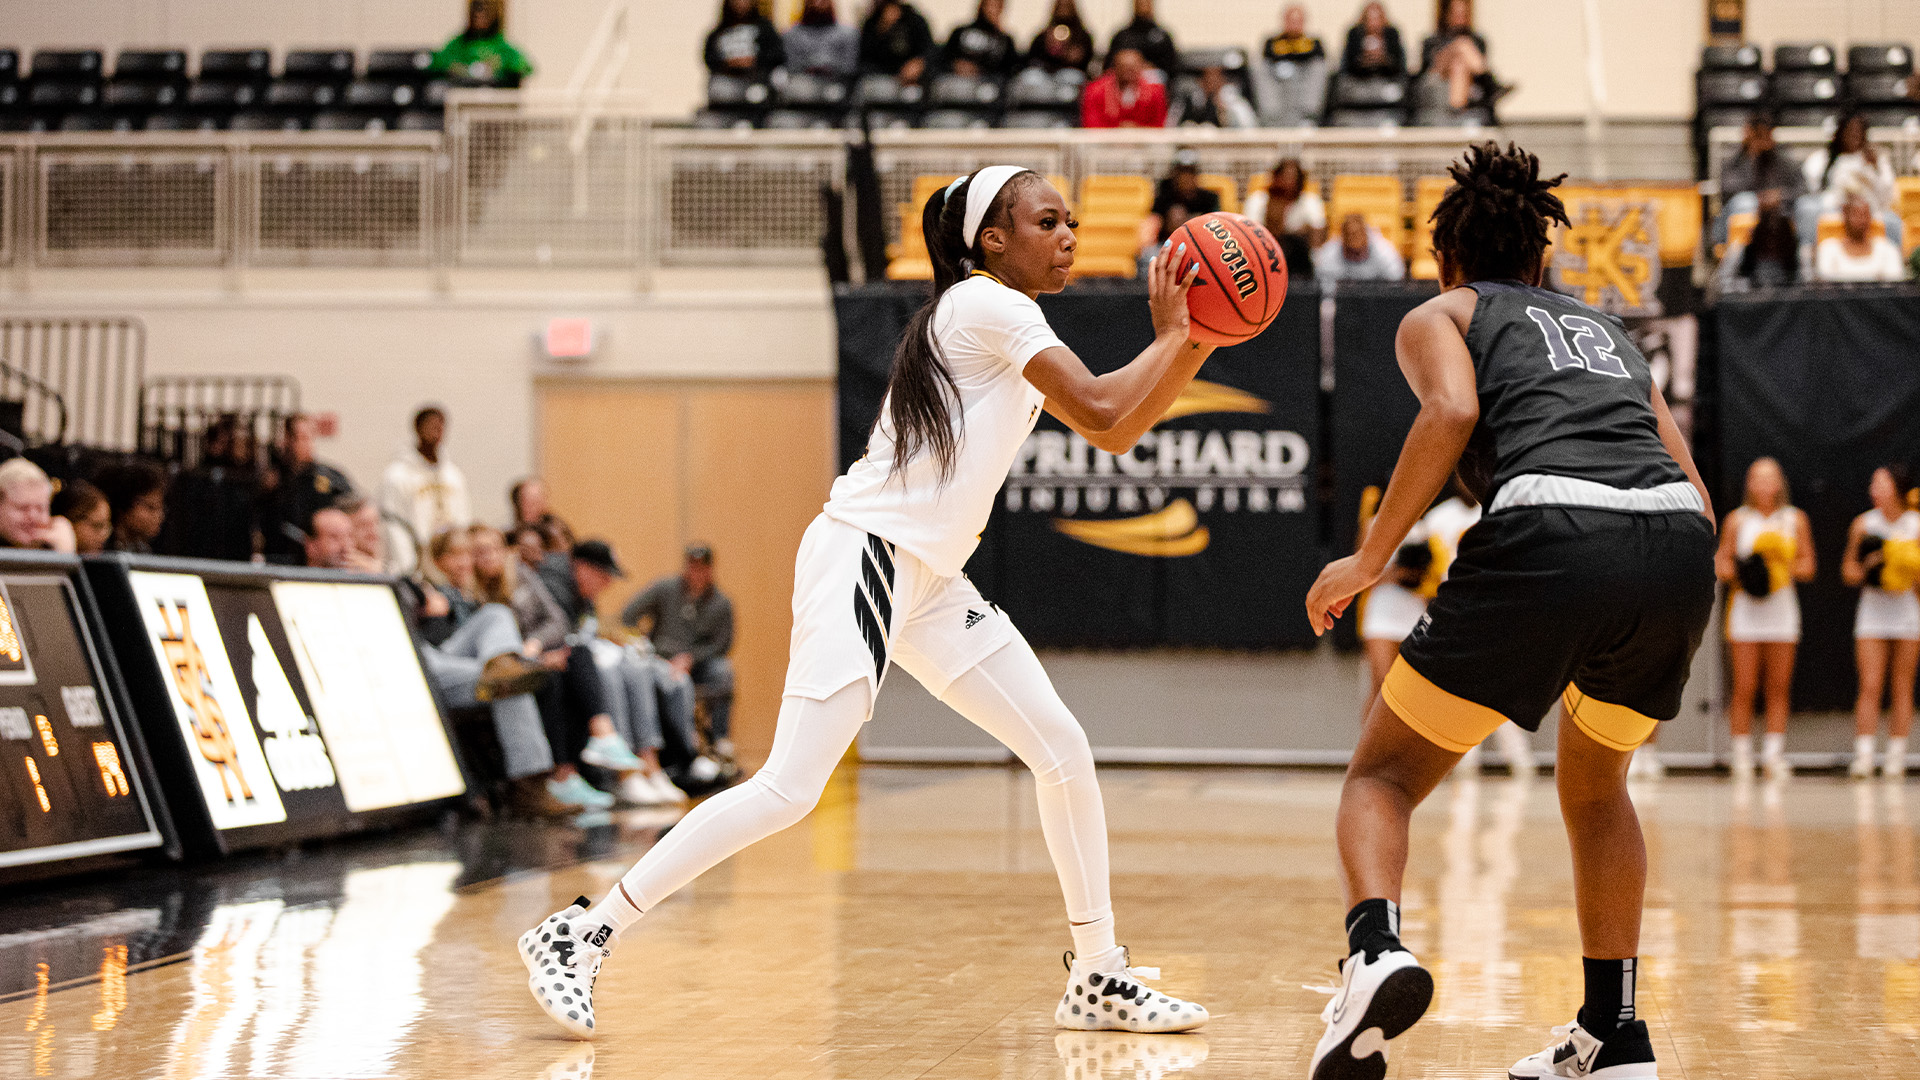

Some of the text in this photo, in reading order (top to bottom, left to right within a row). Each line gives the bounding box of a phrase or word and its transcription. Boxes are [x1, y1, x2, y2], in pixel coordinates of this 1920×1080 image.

[1203, 218, 1258, 303] Wilson
[1525, 305, 1632, 379] 12
[965, 613, 986, 630] adidas
